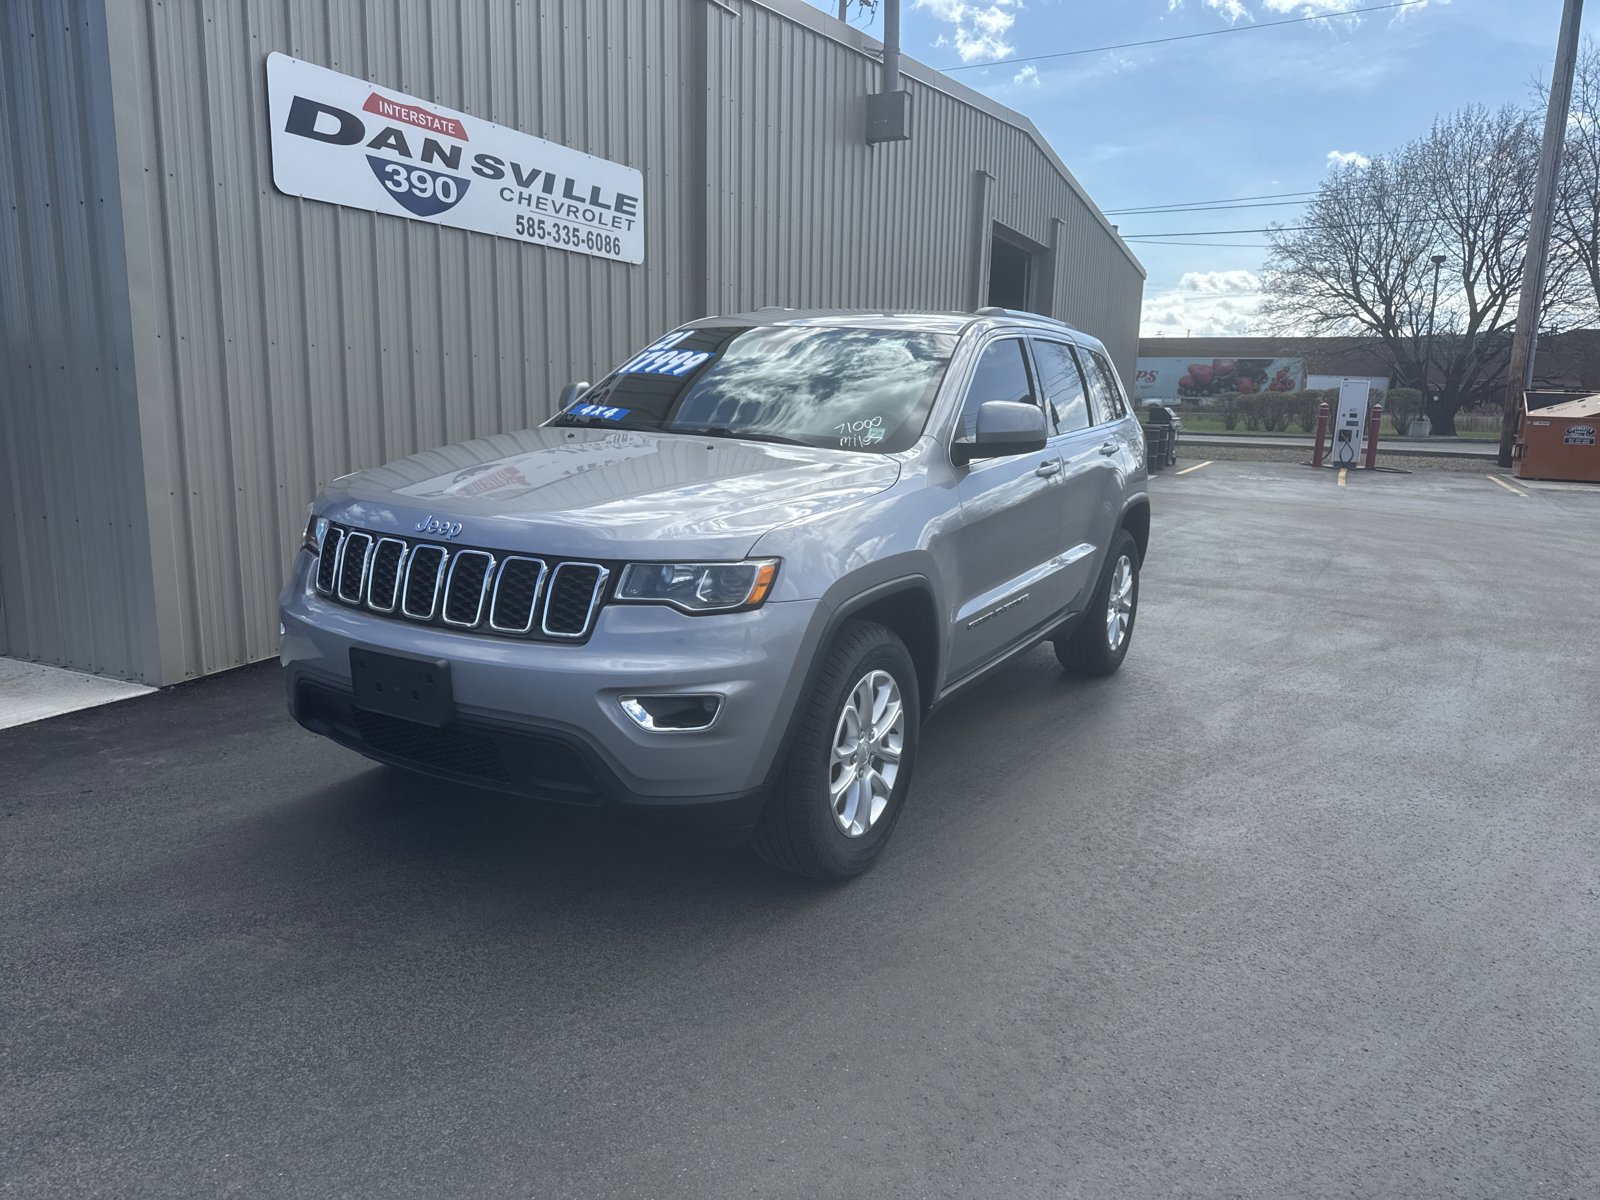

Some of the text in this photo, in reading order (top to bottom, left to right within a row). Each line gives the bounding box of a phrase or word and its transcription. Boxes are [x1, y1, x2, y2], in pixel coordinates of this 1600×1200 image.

[378, 99, 456, 135] INTERSTATE
[284, 95, 639, 217] DANSVILLE
[384, 163, 458, 204] 390
[499, 187, 636, 232] CHEVROLET
[515, 214, 622, 256] 585-335-6086
[617, 350, 709, 375] 17999
[834, 416, 882, 434] 71000
[415, 515, 463, 540] Jeep
